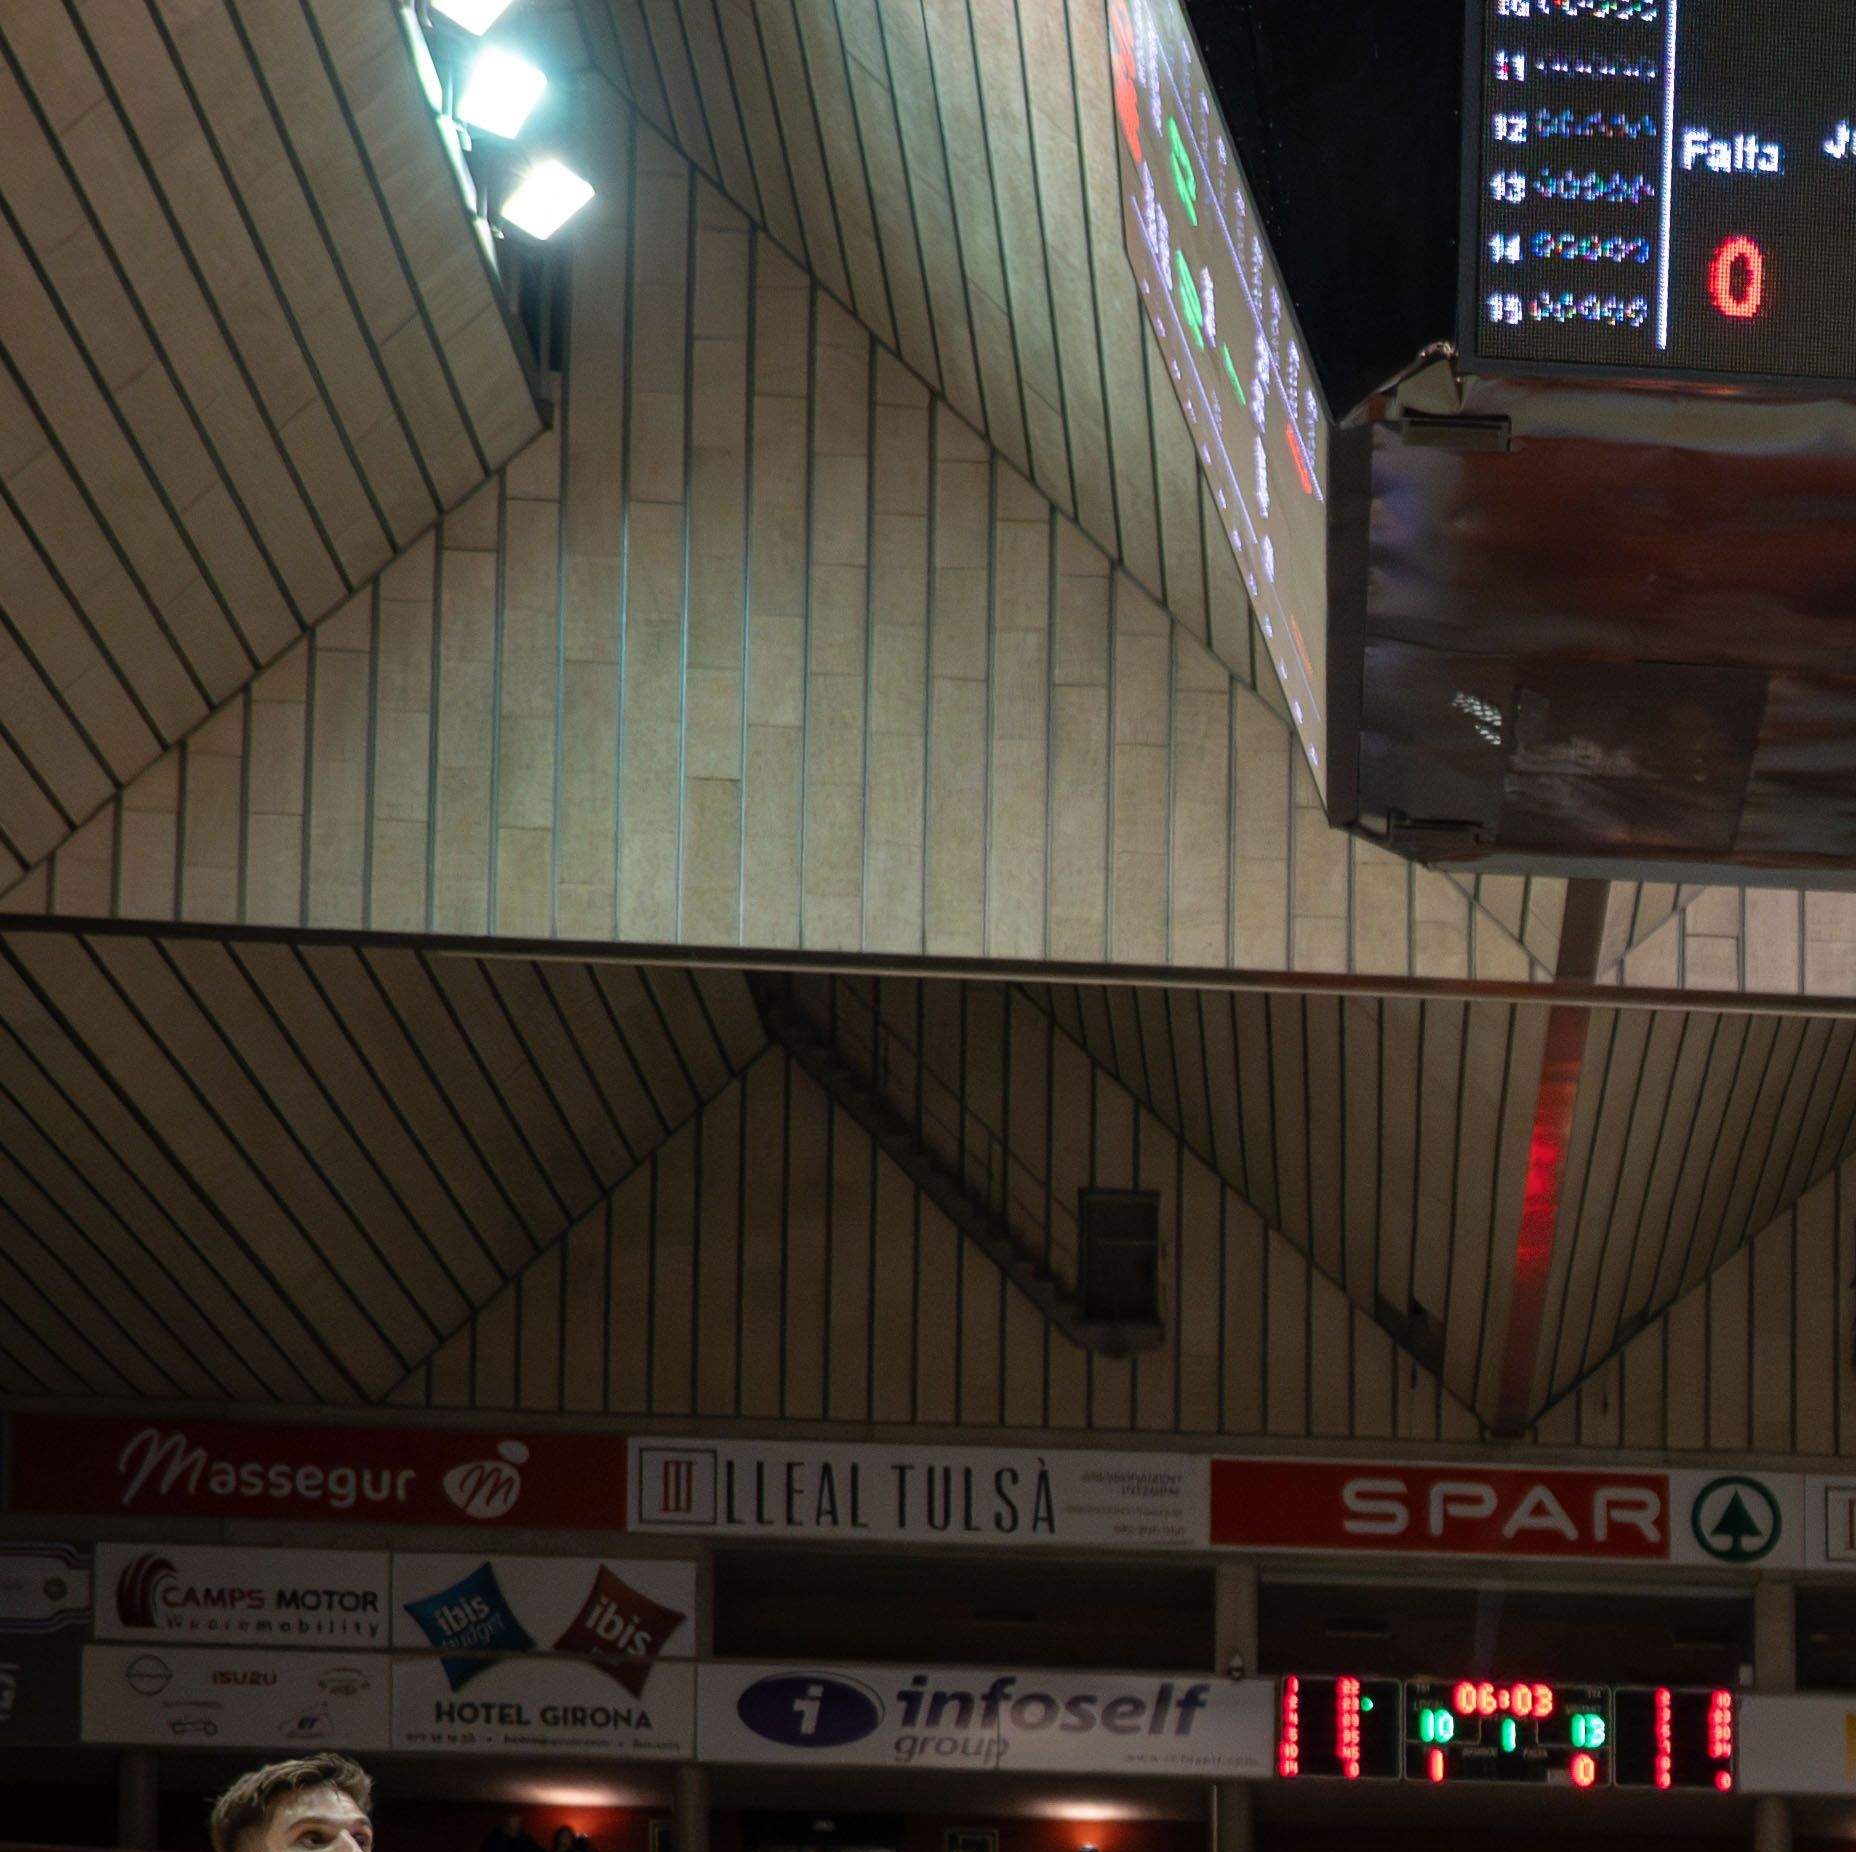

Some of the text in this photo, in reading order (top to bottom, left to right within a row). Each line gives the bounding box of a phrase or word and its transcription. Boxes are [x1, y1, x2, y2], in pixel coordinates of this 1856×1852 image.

[1681, 124, 1784, 176] Falta
[1708, 232, 1763, 320] 0
[119, 1426, 416, 1508] Massegur
[725, 1456, 1056, 1534] LLEAL TULSÀ
[1342, 1477, 1663, 1543] SPAR
[162, 1586, 378, 1613] CAMPS MOTOR
[584, 1596, 652, 1656] ibis
[435, 1700, 652, 1730] HOTEL GIRONA
[895, 1674, 1210, 1737] infoself
[1453, 1680, 1554, 1718] 06:03
[894, 1732, 1009, 1767] group
[1420, 1707, 1455, 1743] 10
[1569, 1712, 1606, 1748] 13
[1569, 1751, 1597, 1790] 0
